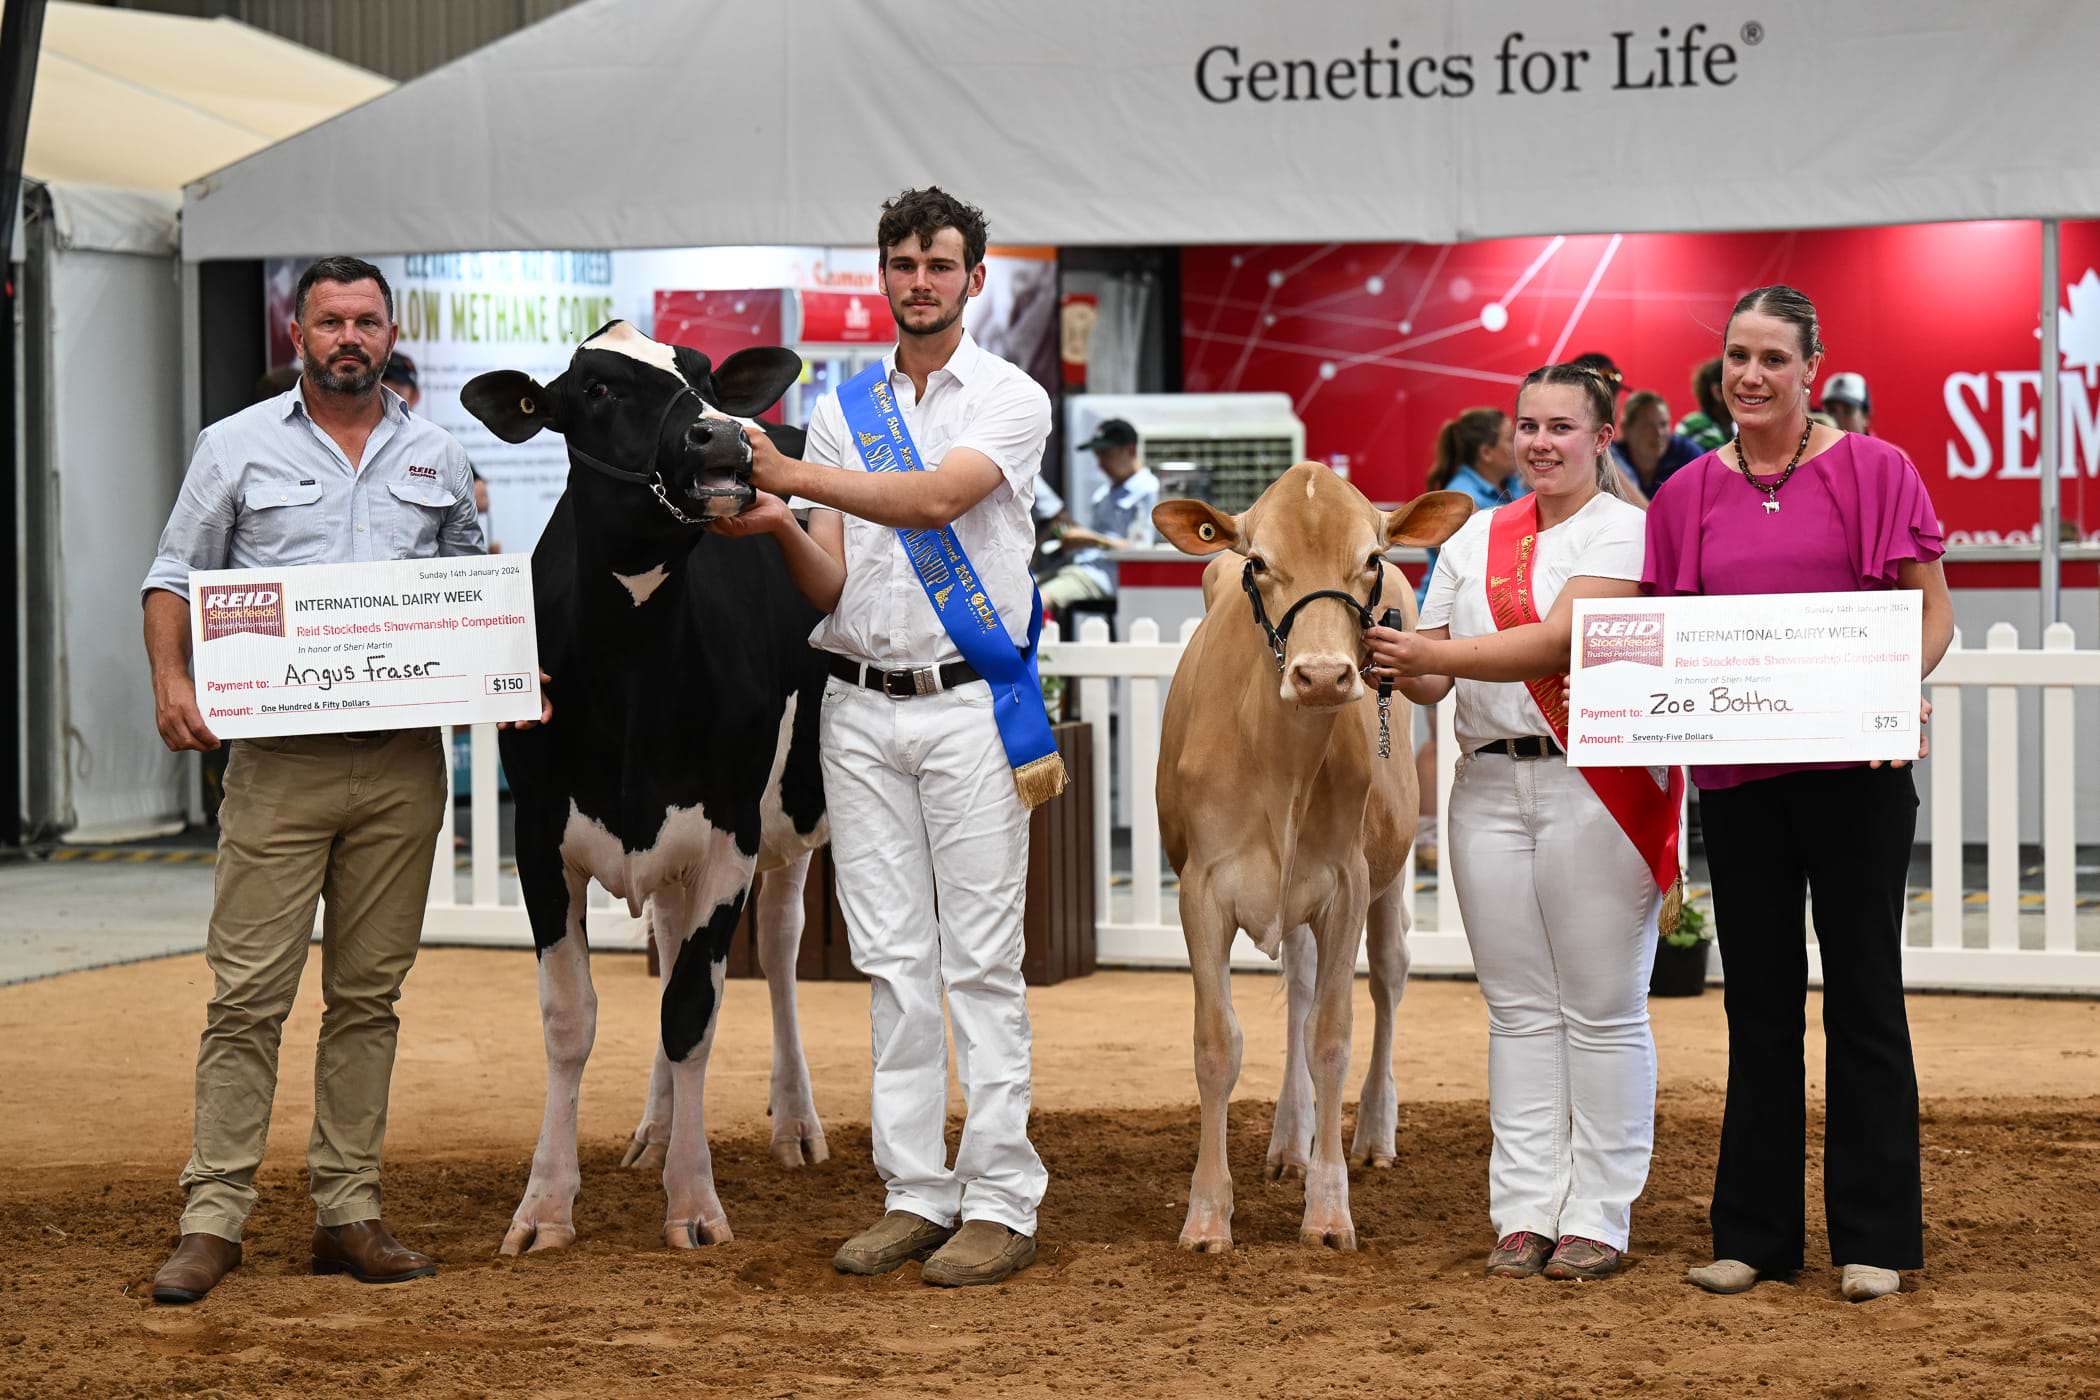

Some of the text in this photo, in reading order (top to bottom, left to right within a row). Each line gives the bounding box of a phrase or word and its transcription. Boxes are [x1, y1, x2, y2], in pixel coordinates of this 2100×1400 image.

[1195, 38, 1475, 104] Genetics
[1495, 33, 1590, 95] for
[395, 288, 441, 343] LOW
[450, 292, 550, 344] METHANE
[408, 465, 437, 475] REID
[419, 571, 448, 580] Sunday
[468, 567, 500, 577] January
[501, 566, 520, 575] 2024
[205, 591, 279, 609] REID
[295, 589, 483, 612] INTERNATIONAL DAIRY WEEK
[209, 608, 276, 620] Stockfeeds
[296, 614, 526, 637] Reid Stockfeeds Showmanship Competition
[1586, 621, 1661, 637] REID
[1676, 626, 1869, 642] INTERNATIONAL DAIRY WEEK
[298, 641, 393, 654] In honor of Sheri Martin
[1589, 637, 1659, 647] Stockfeeds
[1675, 657, 1700, 668] Reid
[1702, 656, 1761, 667] Stockfeeds
[284, 654, 441, 691] Angus Fraser
[1721, 675, 1743, 684] Sheri
[1744, 675, 1772, 683] Martin
[207, 680, 270, 693] Payment to:
[493, 677, 524, 692] $150
[208, 698, 371, 718] Amount: One Hundred & Fifty Dollars
[1650, 687, 1794, 715] Zoe Botha
[1580, 708, 1643, 720] Payment to:
[1874, 715, 1899, 729] $75
[1579, 732, 1714, 744] Amount: Seventy-Five Dollars
